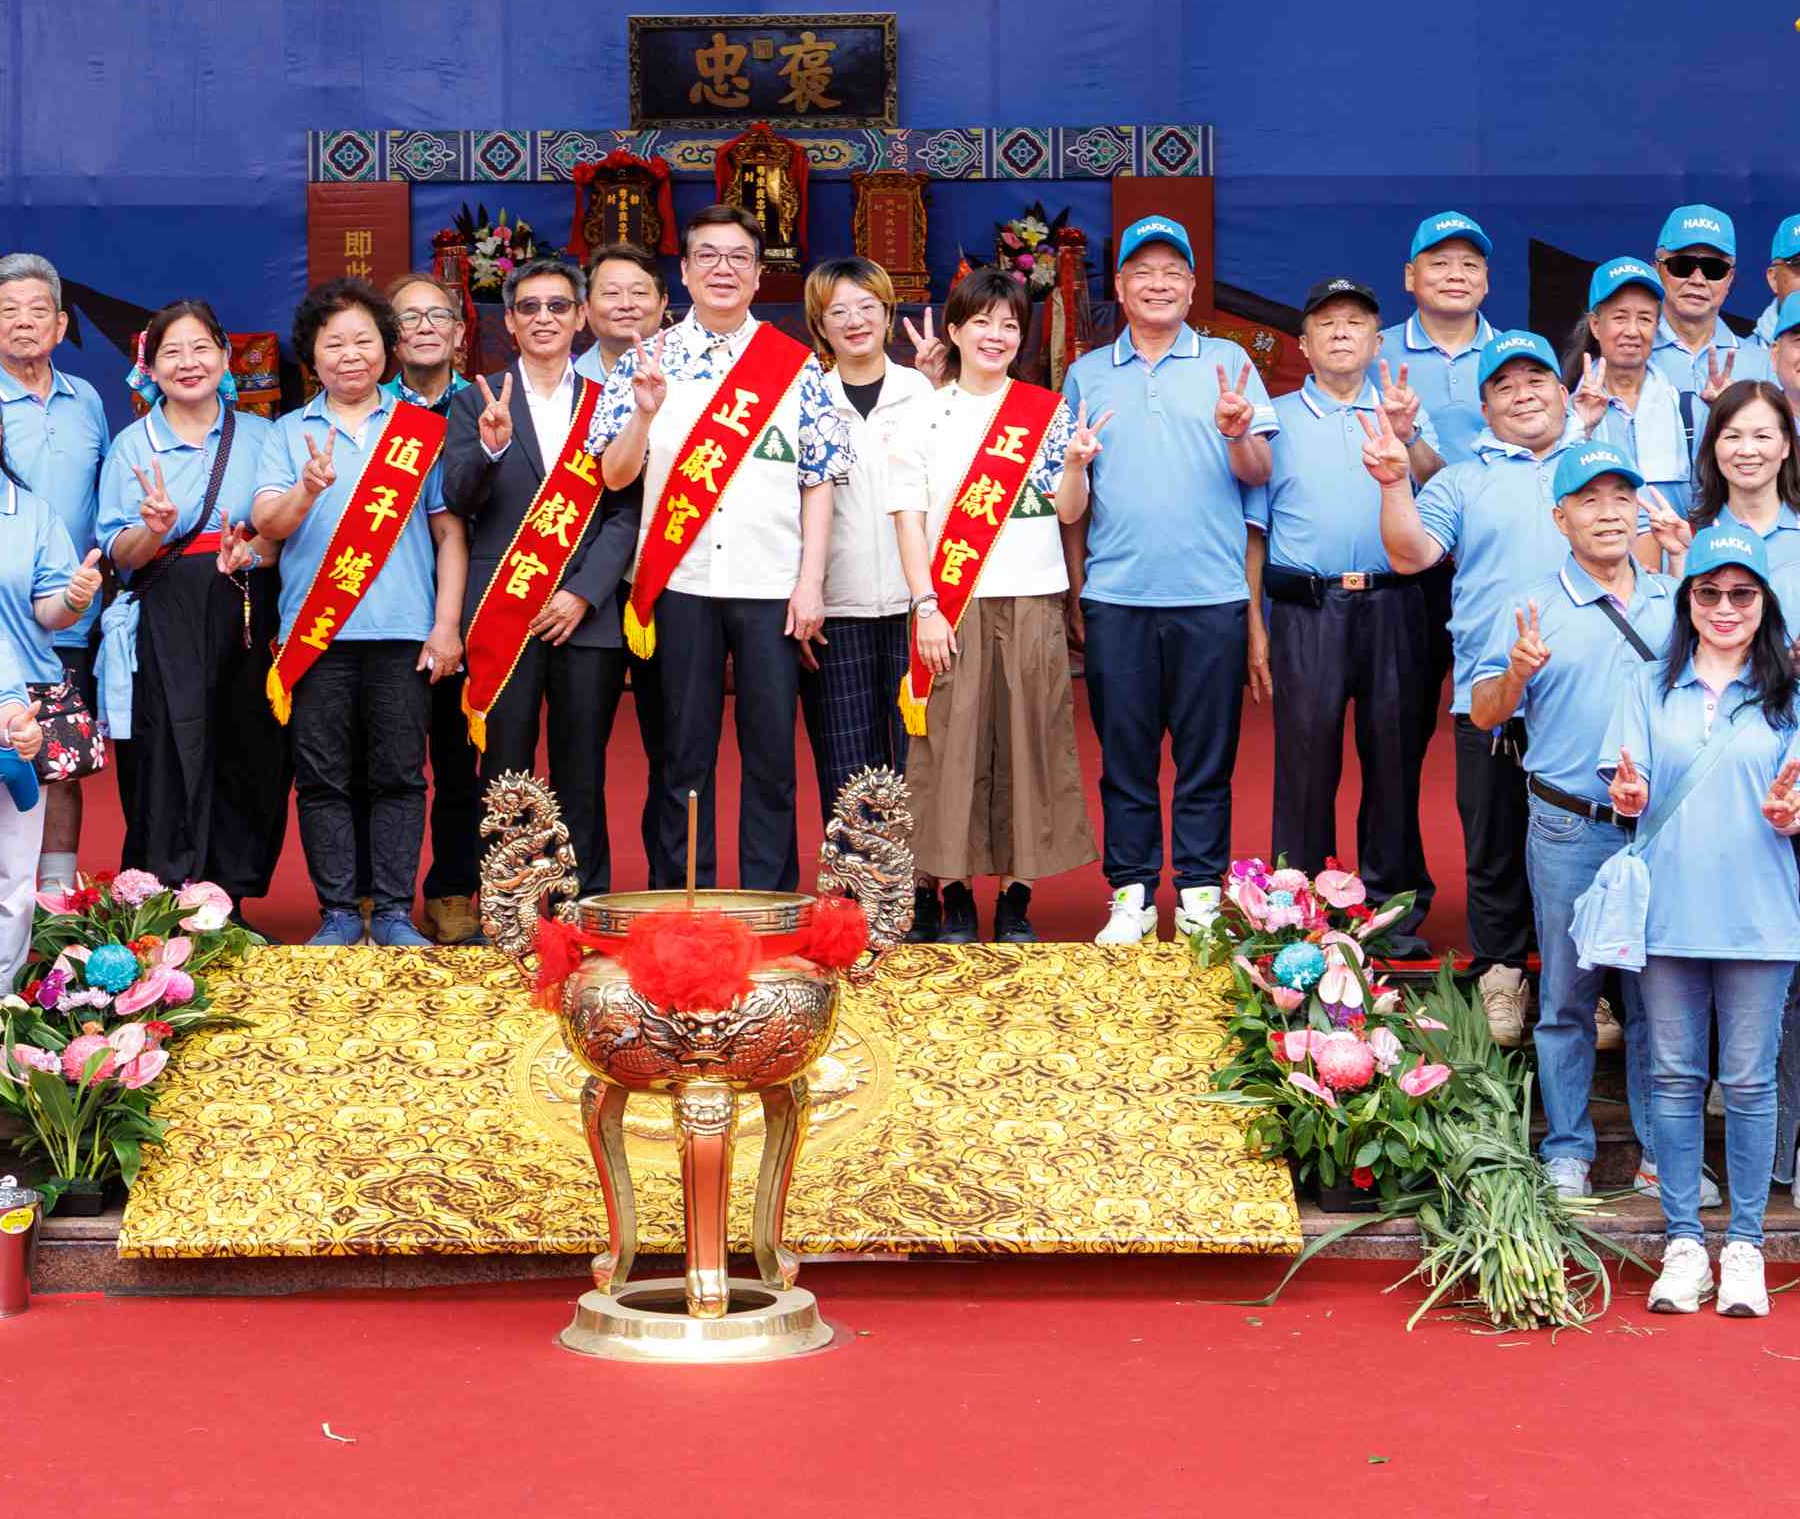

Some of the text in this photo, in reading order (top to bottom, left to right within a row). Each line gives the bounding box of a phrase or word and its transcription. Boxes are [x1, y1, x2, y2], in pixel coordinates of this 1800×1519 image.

[688, 31, 842, 114] 褒忠
[1683, 218, 1721, 233] HAKKA
[1609, 264, 1647, 278] HAKKA
[1496, 336, 1536, 353] HAKKA
[663, 386, 761, 545] 正獻官
[1580, 450, 1622, 466] HAKKA
[504, 447, 600, 600] 正獻官
[939, 424, 1030, 586] 正獻官
[299, 435, 424, 652] 值年爐主
[1709, 536, 1753, 556] HAKKA
